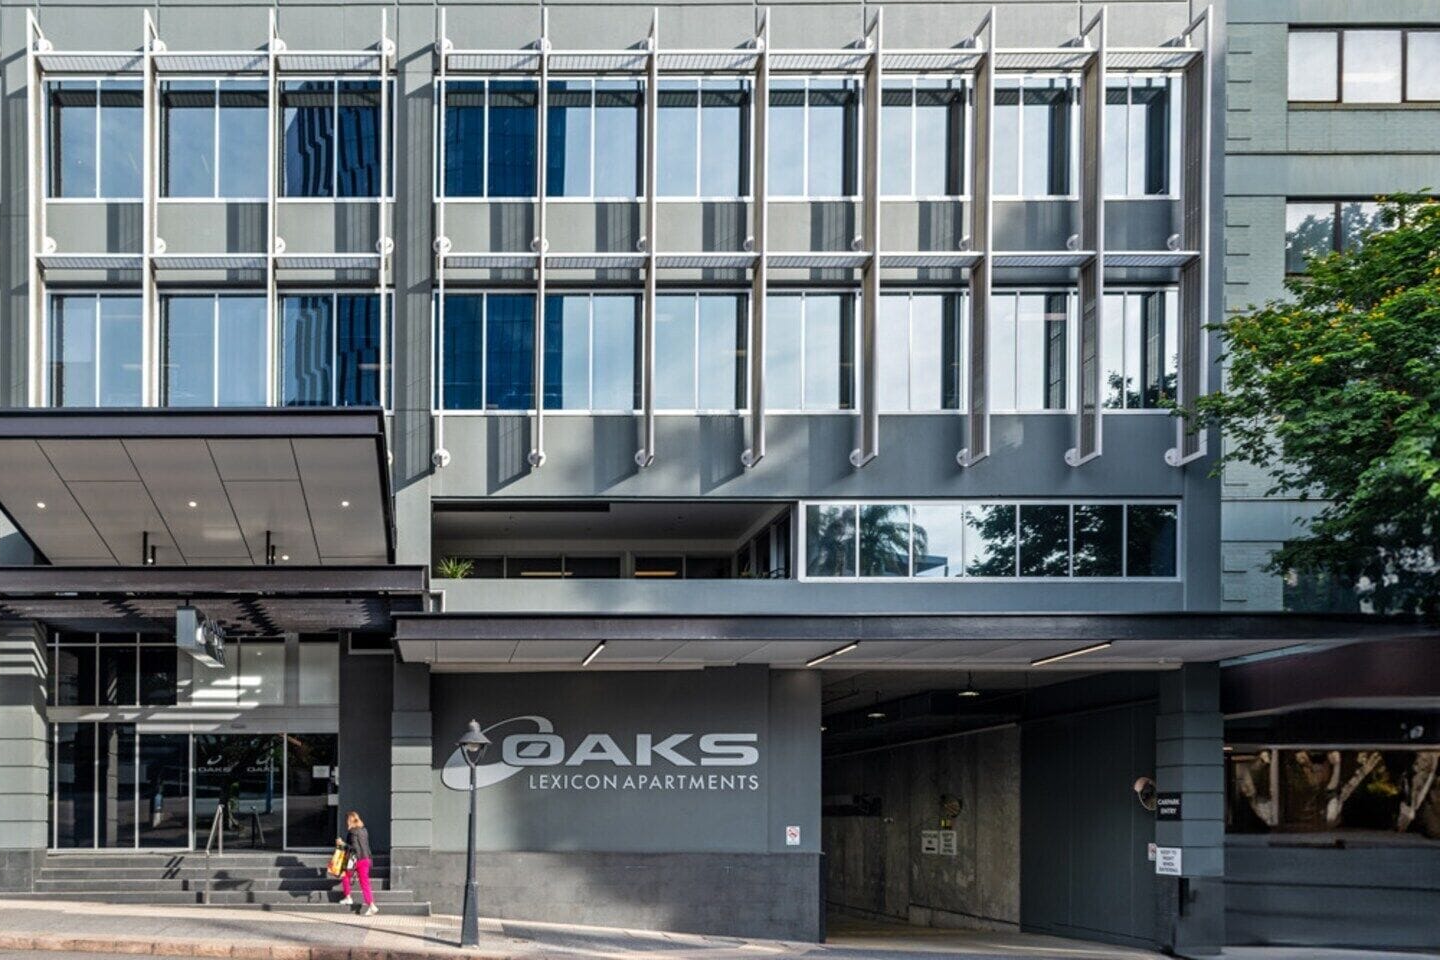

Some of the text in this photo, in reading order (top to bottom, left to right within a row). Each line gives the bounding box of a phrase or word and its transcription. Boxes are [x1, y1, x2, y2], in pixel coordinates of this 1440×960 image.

[502, 733, 759, 766] OAKS
[529, 774, 760, 790] LEXICON APARTMENTS
[1160, 807, 1177, 815] ENTRY
